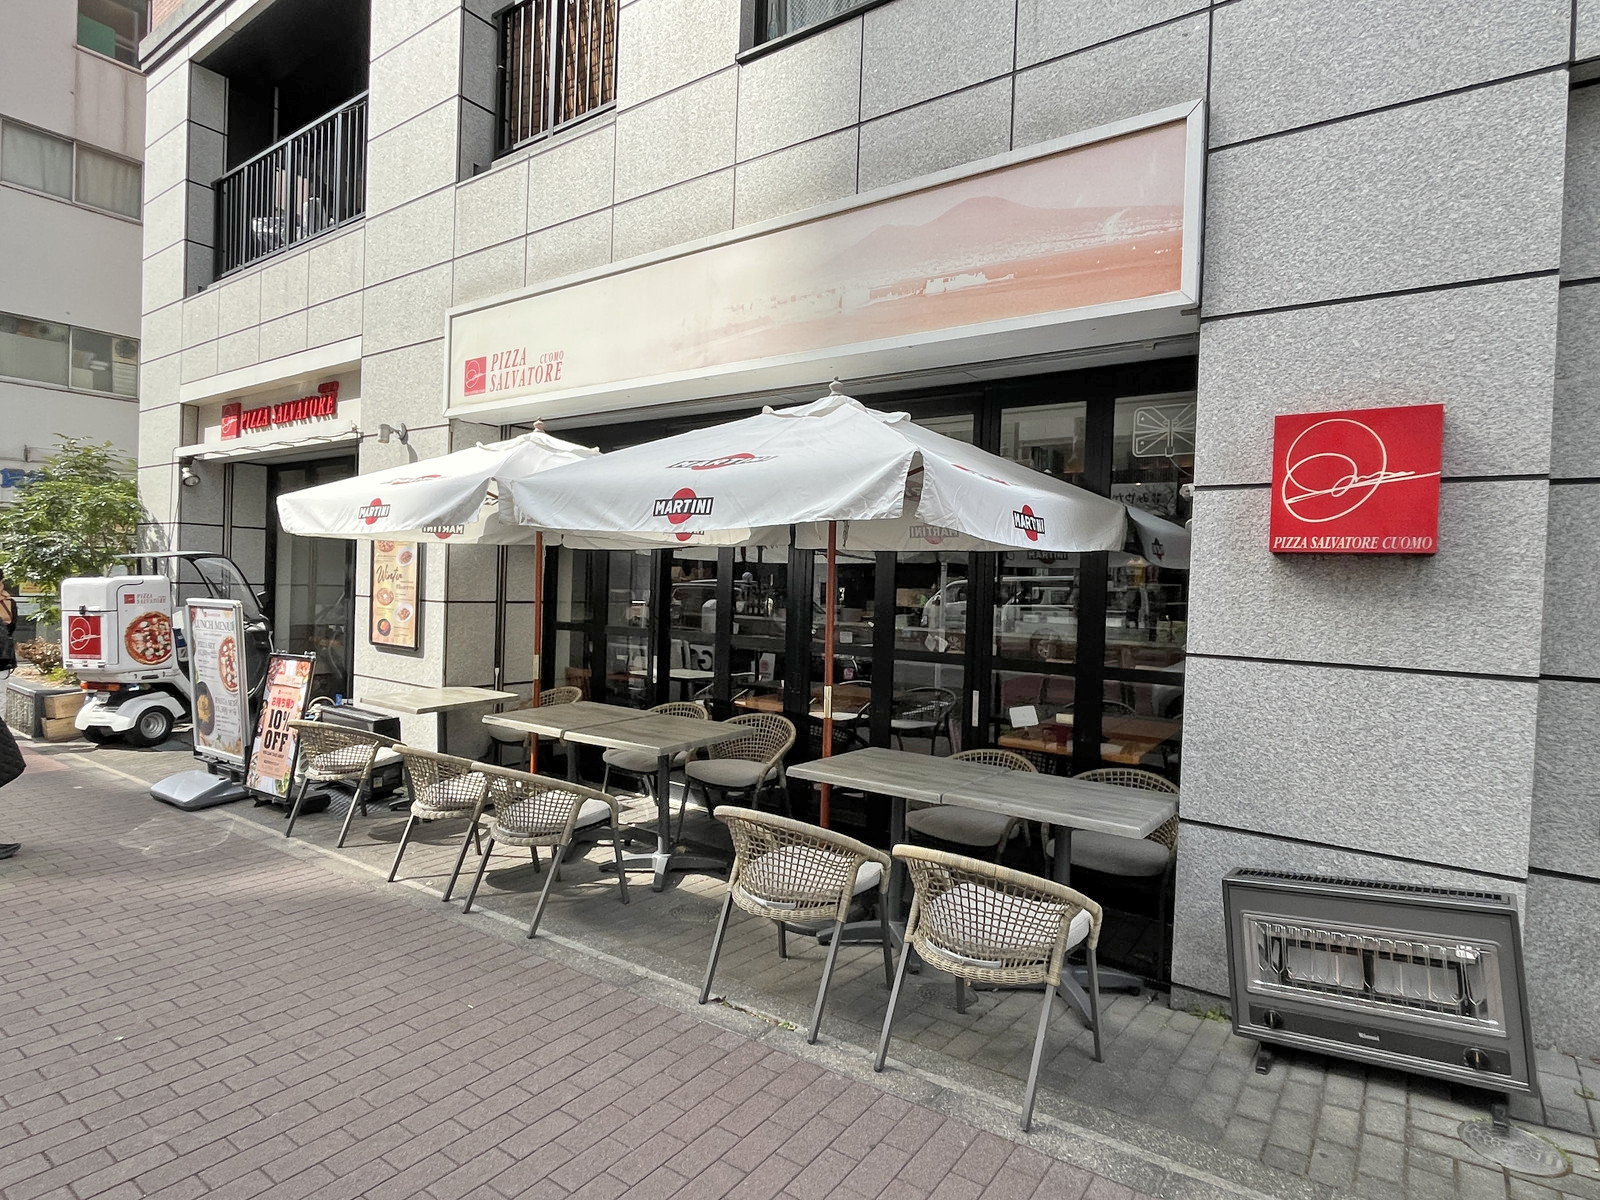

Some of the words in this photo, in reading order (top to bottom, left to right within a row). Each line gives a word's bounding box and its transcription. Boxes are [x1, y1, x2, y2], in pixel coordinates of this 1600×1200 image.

[490, 347, 527, 371] PIZZA
[539, 350, 565, 365] CUOMO
[489, 361, 563, 392] SALVATORE
[240, 408, 269, 430] PIZZA
[360, 505, 391, 518] MARTINI
[655, 499, 711, 515] MARTINI
[1014, 512, 1045, 533] MARTINI
[1273, 536, 1308, 549] PIZZA
[1310, 536, 1378, 549] SALVATORE
[1382, 536, 1433, 550] CUOMO
[268, 709, 290, 732] 10%
[264, 730, 289, 752] OFF
